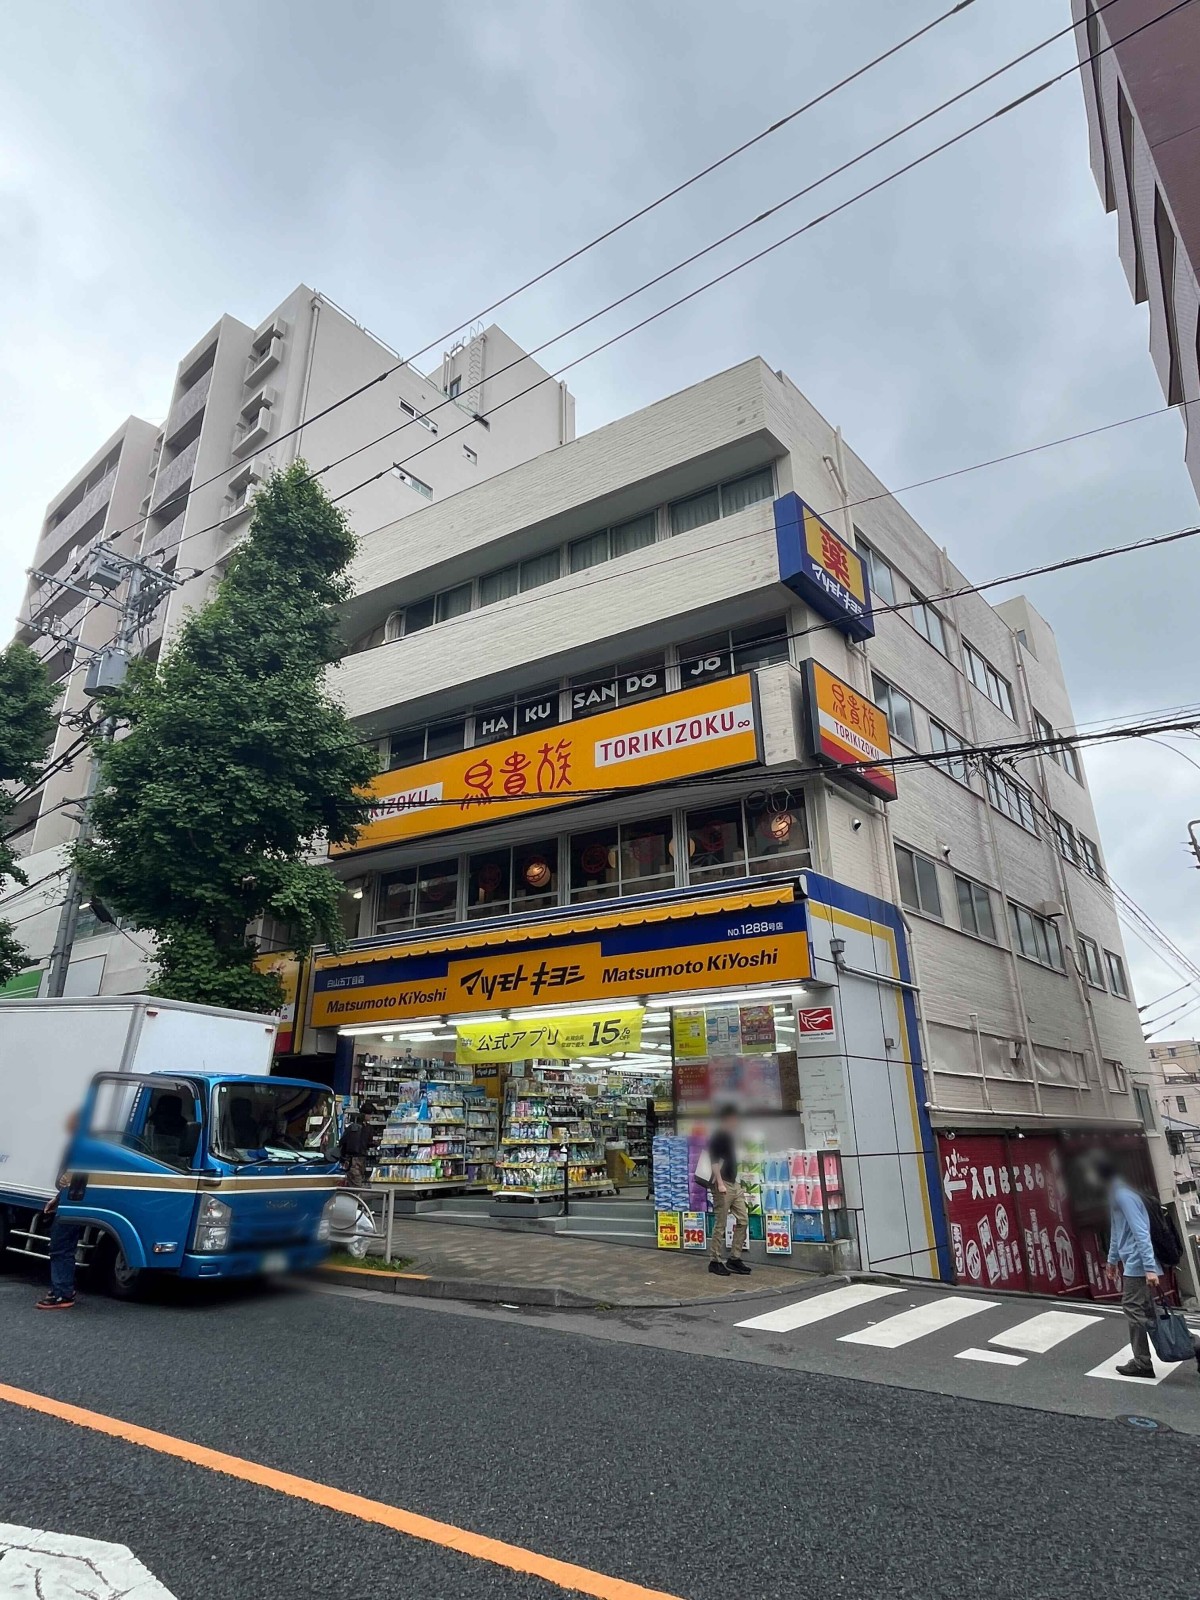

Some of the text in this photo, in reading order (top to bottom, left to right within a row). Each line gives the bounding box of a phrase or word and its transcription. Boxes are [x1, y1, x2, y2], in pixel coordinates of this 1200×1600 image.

[819, 526, 851, 589] 薬
[482, 656, 721, 735] HA KU SAN DO JO
[600, 711, 735, 761] TORIKIZOKU
[833, 720, 880, 761] TORIKIZOKU
[460, 961, 585, 1001] マツモトキヨシ
[602, 948, 779, 985] Matsumoto KiYoshi
[326, 987, 448, 1014] Matsumoto KiYoshi
[476, 1026, 559, 1051] 公式アプリ
[767, 1232, 789, 1247] 328
